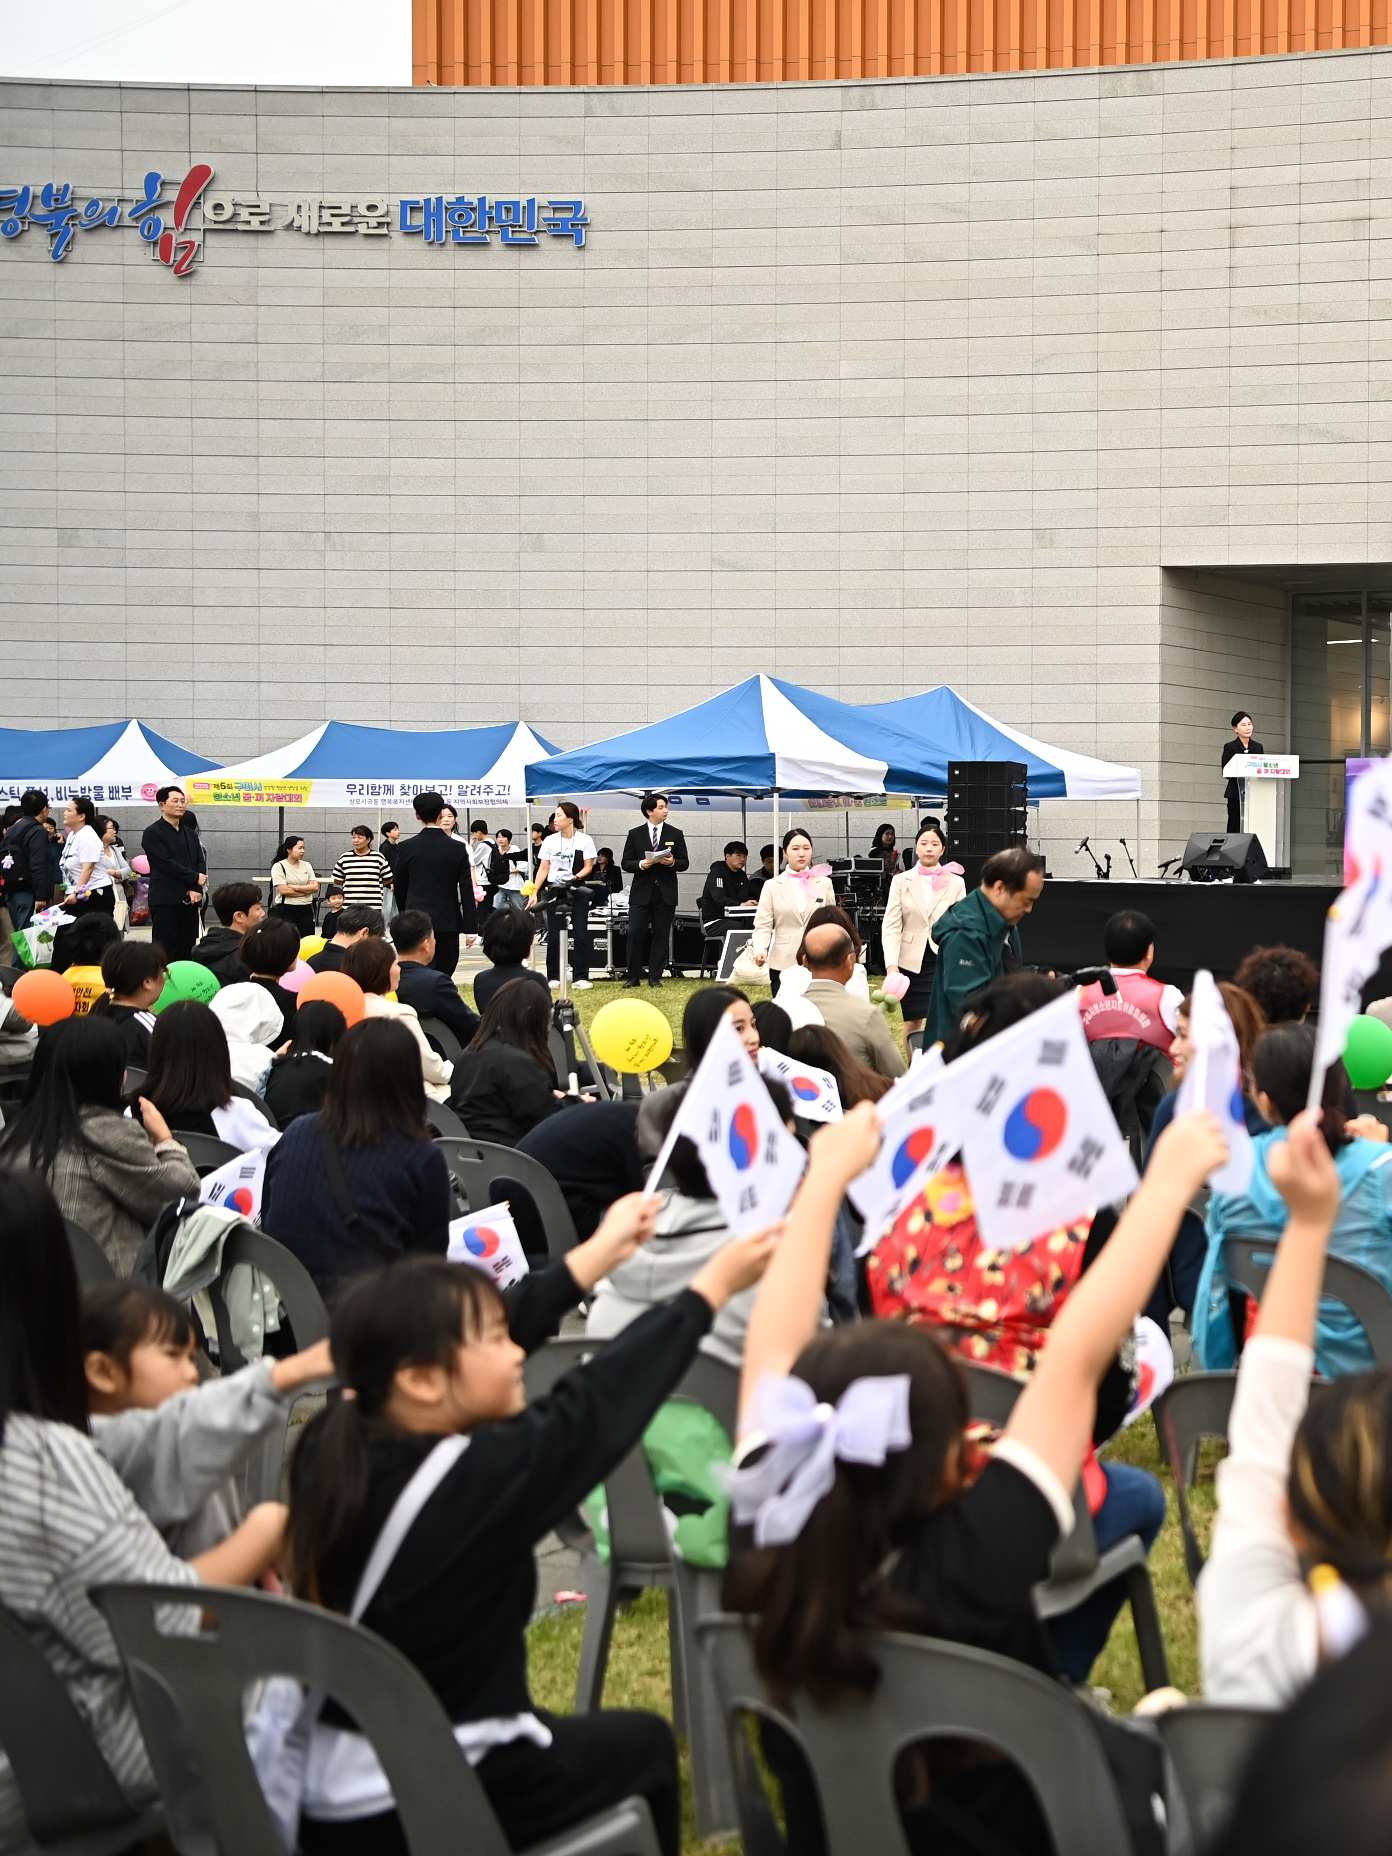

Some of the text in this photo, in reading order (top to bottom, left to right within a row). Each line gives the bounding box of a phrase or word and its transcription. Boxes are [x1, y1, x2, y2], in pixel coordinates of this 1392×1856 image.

[281, 198, 392, 235] 새로운
[400, 195, 593, 247] 대한민국
[55, 785, 105, 801] 비누방울
[109, 786, 132, 800] 배부
[234, 781, 263, 791] 구미시
[346, 783, 511, 797] 우리함께 찾아보고! 알려주고!
[266, 793, 303, 803] 자랑대회
